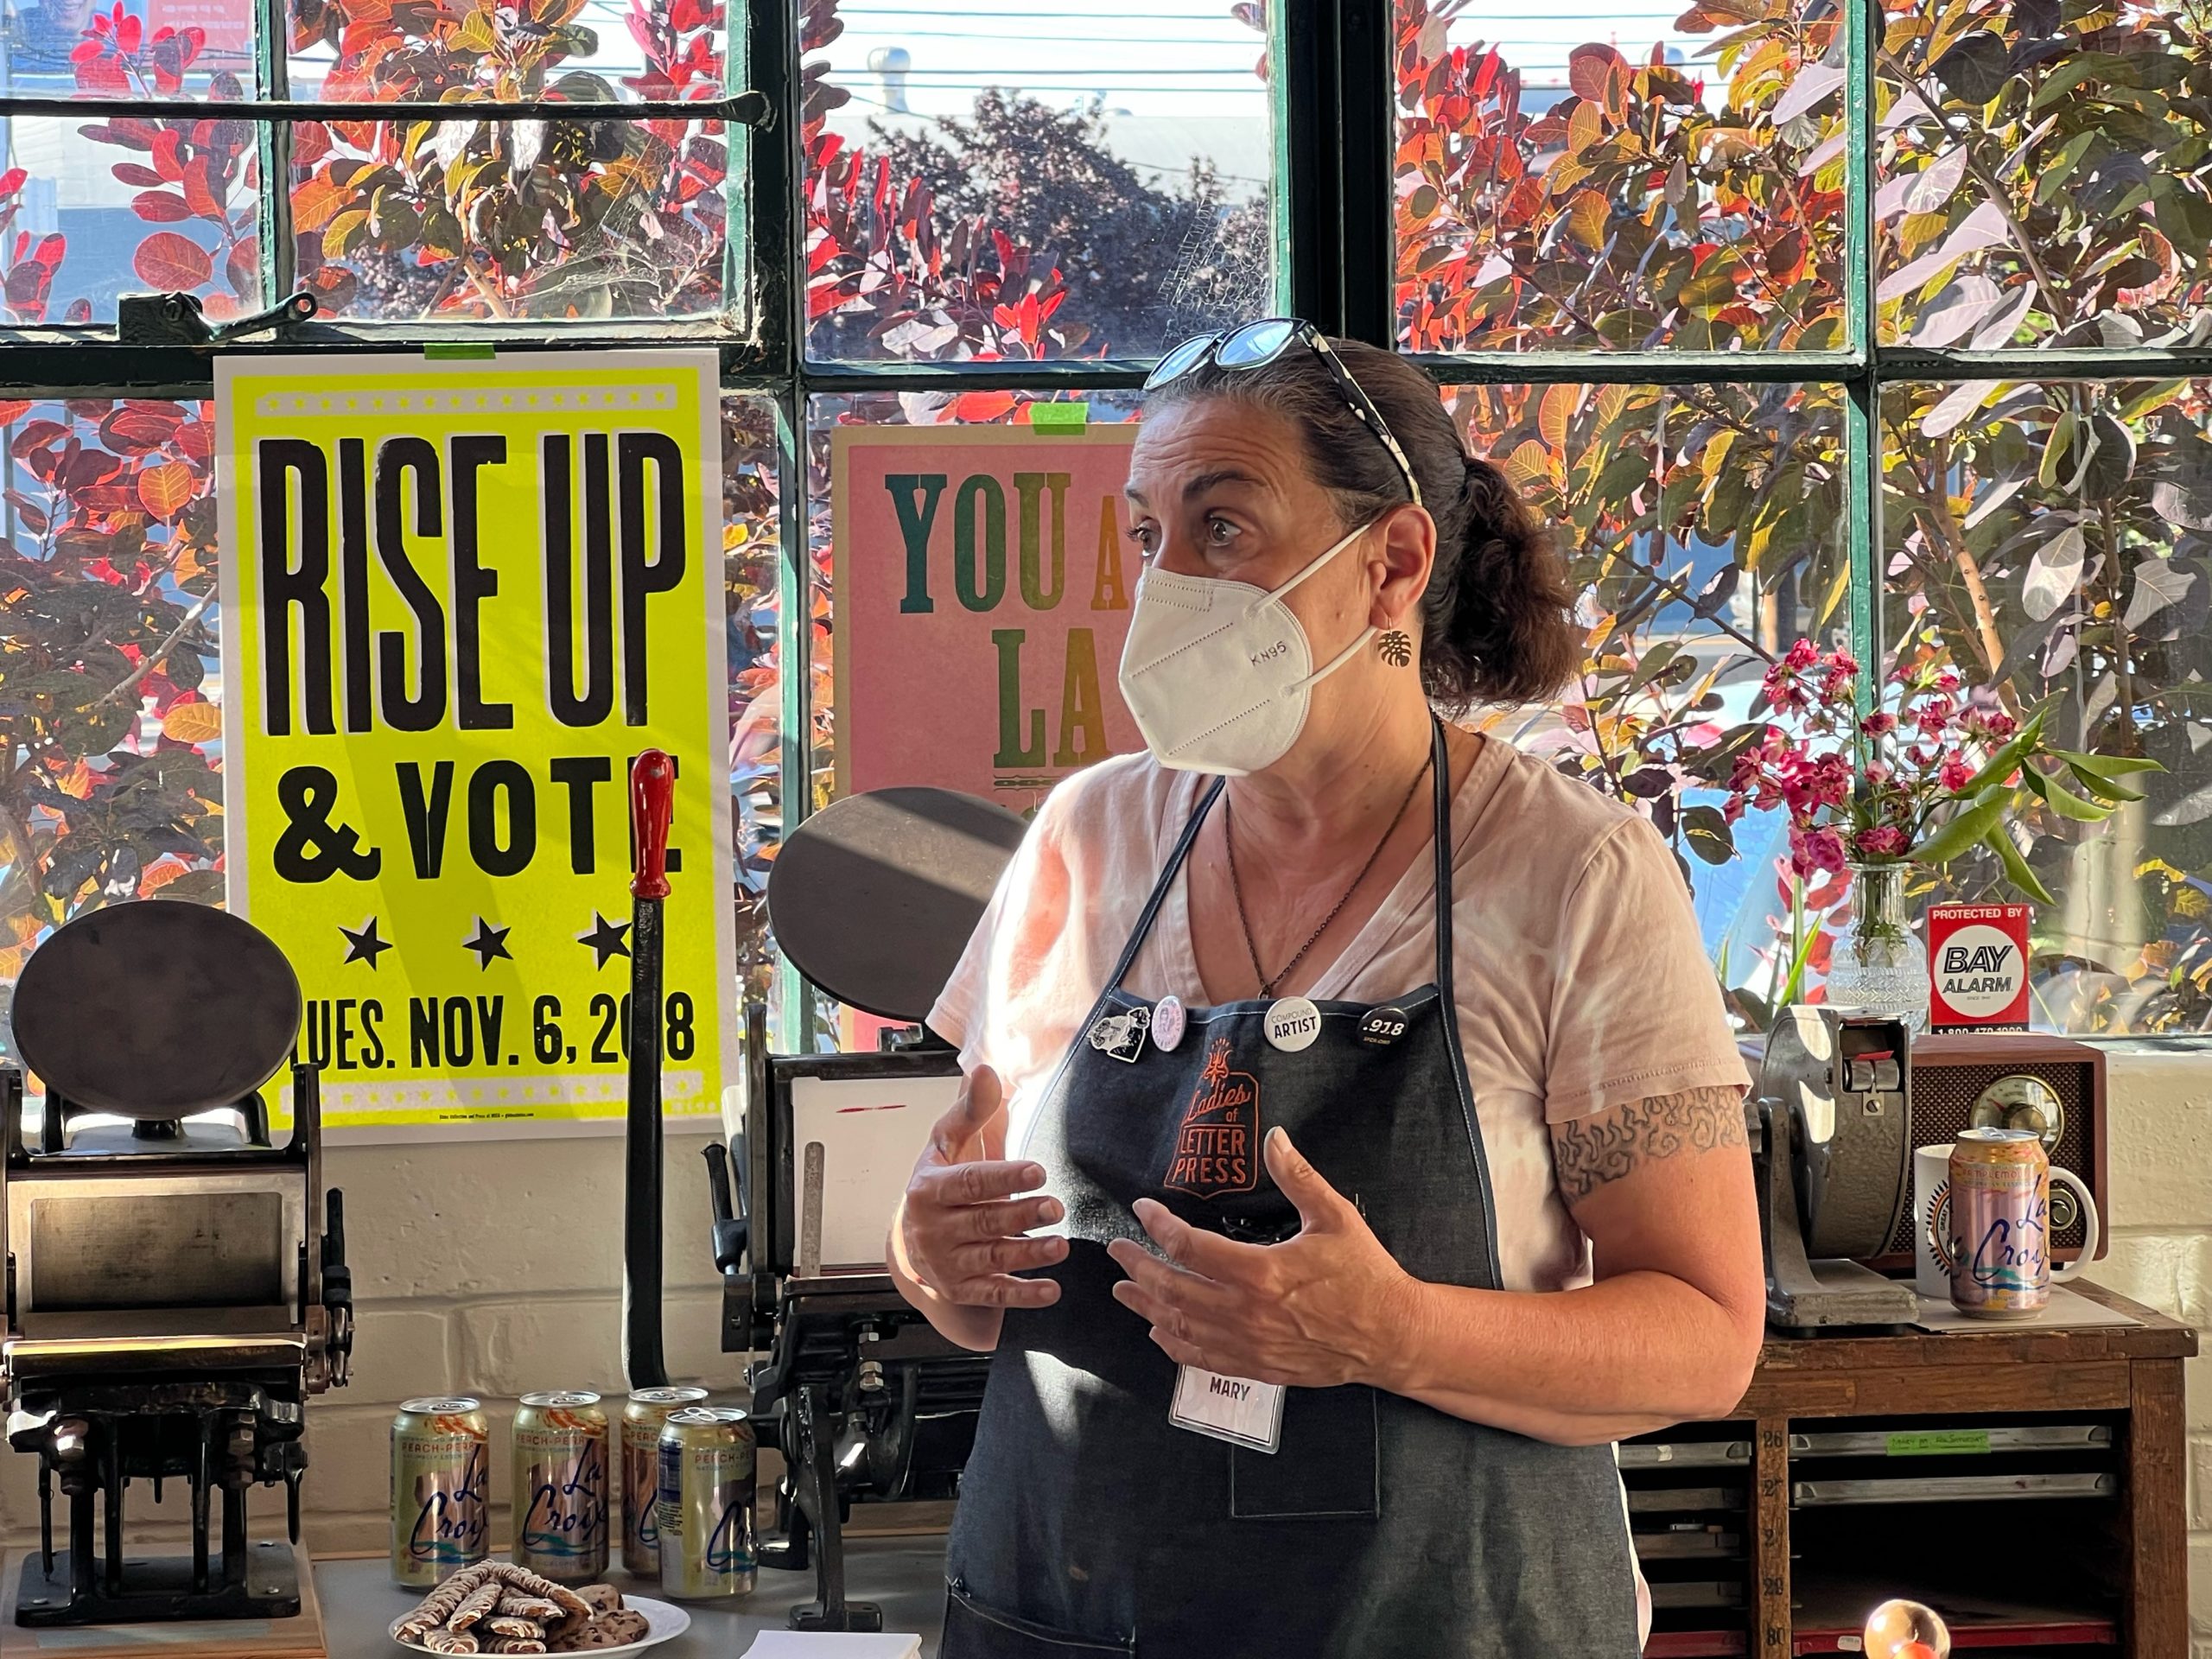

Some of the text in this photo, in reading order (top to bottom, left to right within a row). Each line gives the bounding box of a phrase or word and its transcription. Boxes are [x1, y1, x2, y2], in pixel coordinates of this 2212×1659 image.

[885, 472, 1071, 614] YOU
[258, 432, 686, 737] RISE UP
[1249, 640, 1287, 666] KN95
[273, 766, 381, 884] &
[1932, 907, 2023, 920] PROTECTED BY
[1943, 944, 2014, 974] BAY
[1942, 976, 2012, 994] ALARM
[1271, 1007, 1313, 1024] COMPOUND
[1274, 1016, 1317, 1039] ARTIST
[290, 991, 695, 1072] UES. NOV. 6, 28
[1186, 1078, 1252, 1122] Ladies
[1225, 1108, 1239, 1122] of
[1180, 1128, 1245, 1156] LETTER
[1171, 1157, 1247, 1184] PRESS
[2016, 1173, 2048, 1232] La
[1209, 1376, 1251, 1402] MARY
[1763, 1430, 1783, 1448] 26
[562, 1438, 602, 1496] La
[695, 1452, 750, 1464] PEACH-PE
[454, 1443, 488, 1503] La
